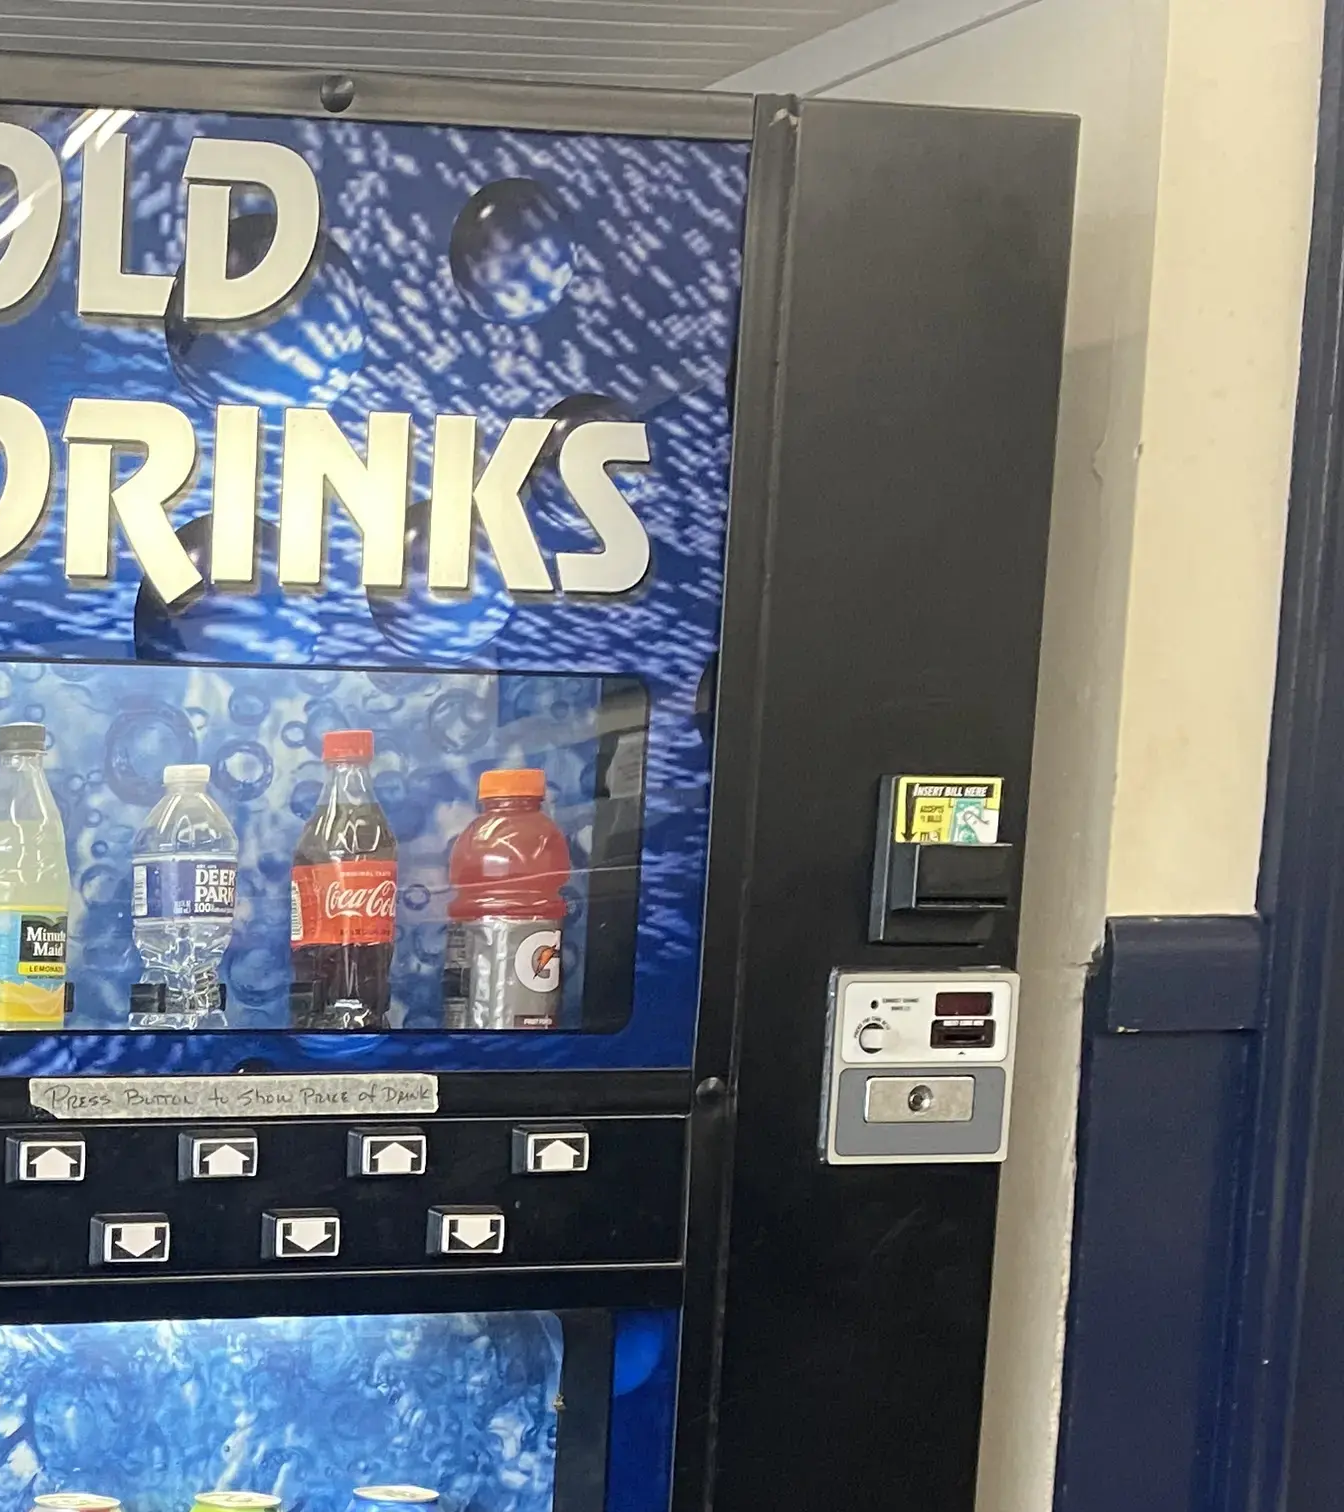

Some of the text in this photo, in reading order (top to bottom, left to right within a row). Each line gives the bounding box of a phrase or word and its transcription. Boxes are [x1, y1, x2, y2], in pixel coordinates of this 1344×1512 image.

[913, 783, 988, 797] INSERT BILL HERE
[196, 868, 236, 886] DEER
[195, 886, 234, 905] PARK
[33, 942, 63, 956] Maid
[515, 930, 561, 992] G
